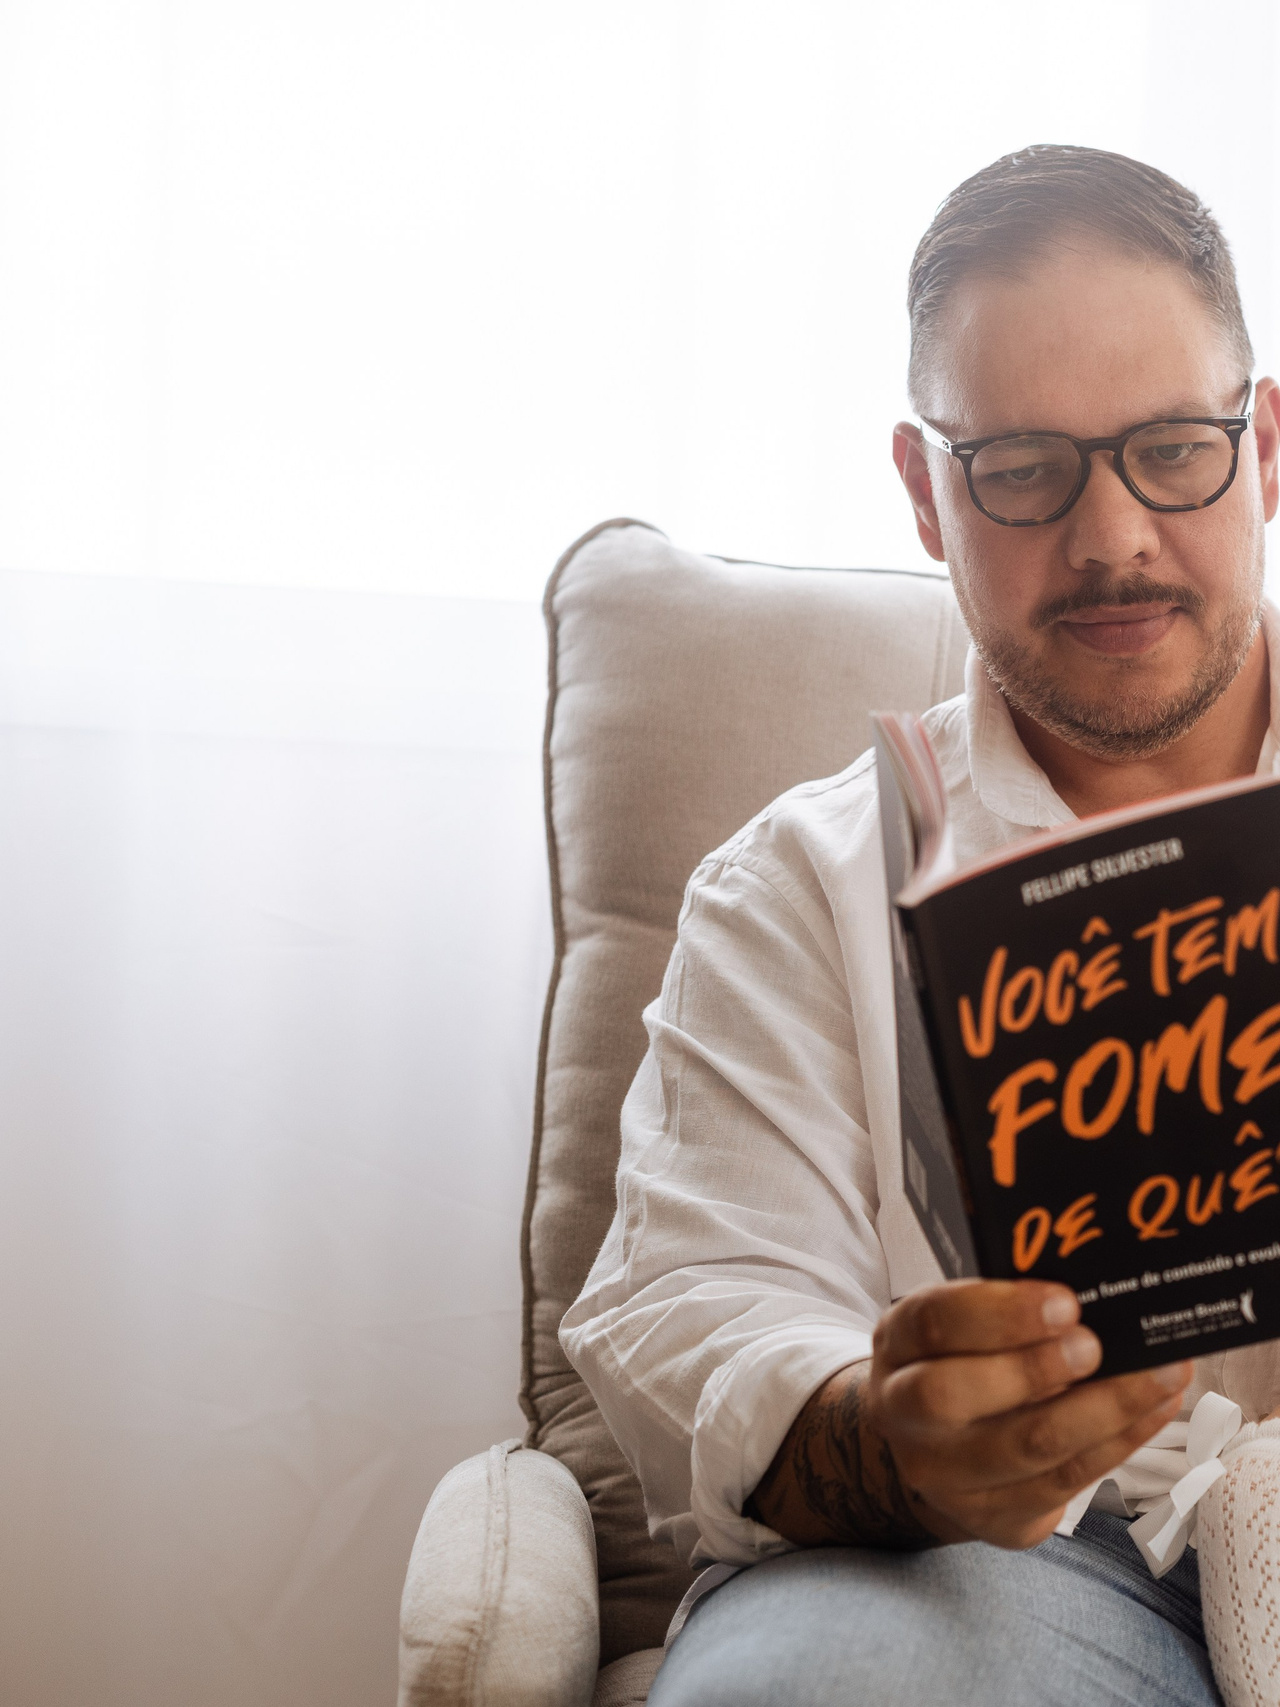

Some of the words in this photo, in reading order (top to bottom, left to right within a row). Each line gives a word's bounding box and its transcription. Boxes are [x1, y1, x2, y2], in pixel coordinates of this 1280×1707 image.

[1020, 862, 1092, 906] FELLIPE
[1090, 837, 1184, 884] SILVESTER
[958, 915, 1128, 1059] VOCÊ
[1012, 1194, 1102, 1272] DE
[1077, 1288, 1099, 1305] ua
[1099, 1281, 1139, 1298] fome
[1140, 1270, 1161, 1288] de
[1162, 1256, 1234, 1283] conteúdo
[1234, 1253, 1246, 1267] e
[1195, 1299, 1239, 1319] Books
